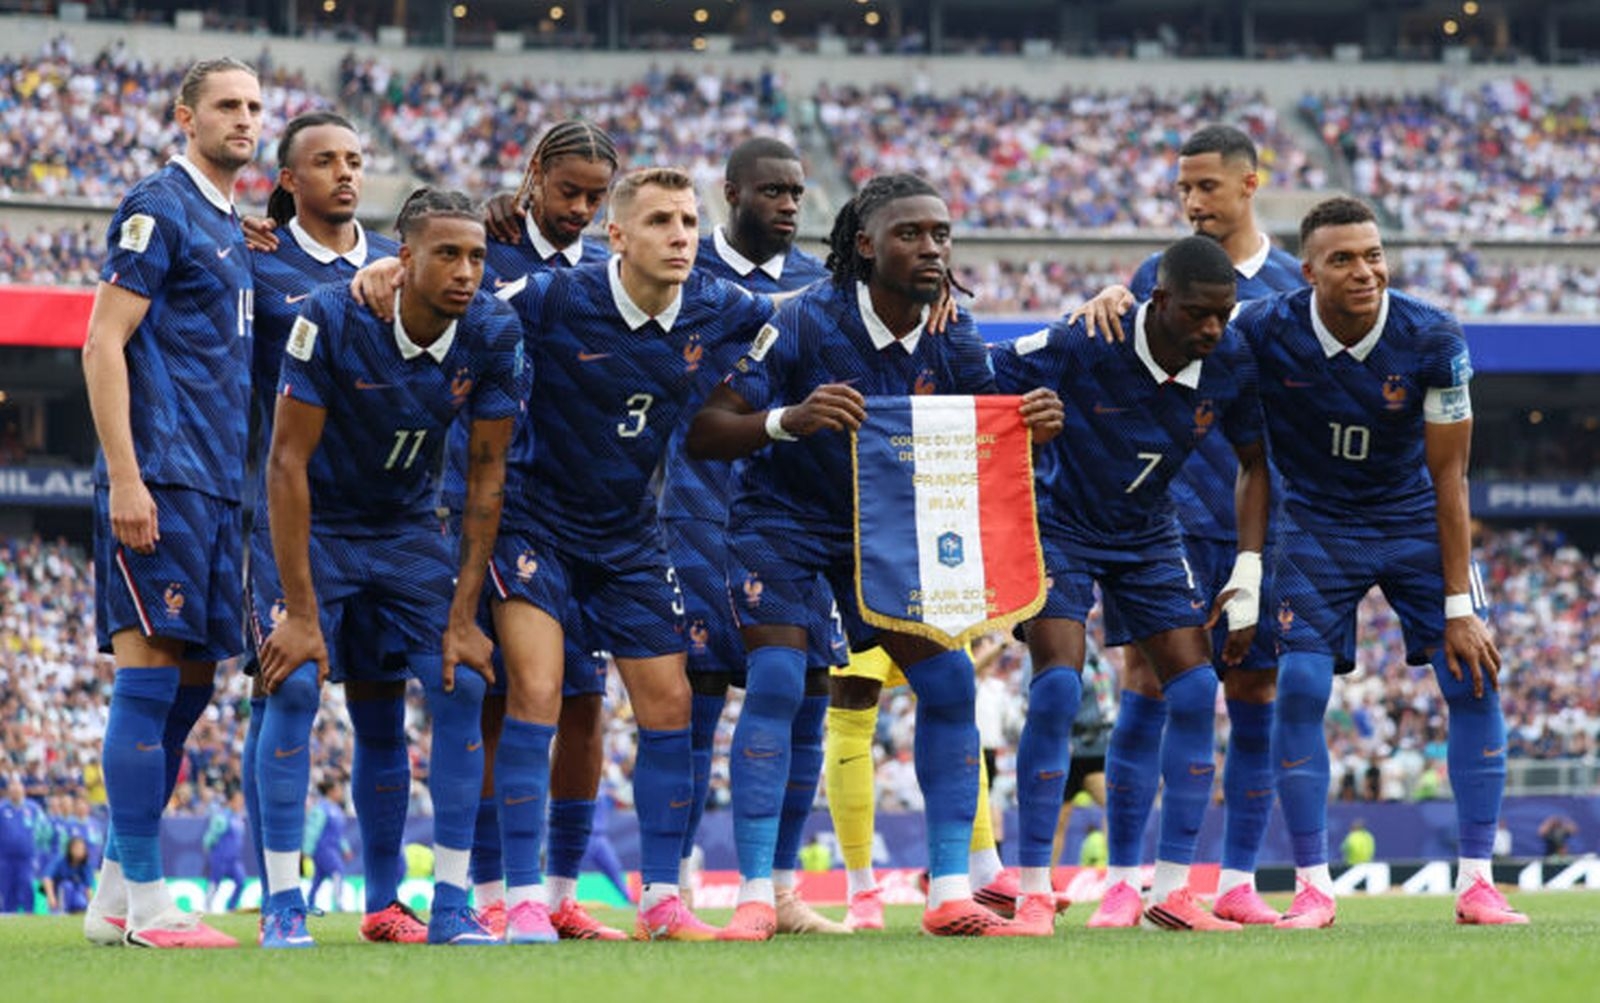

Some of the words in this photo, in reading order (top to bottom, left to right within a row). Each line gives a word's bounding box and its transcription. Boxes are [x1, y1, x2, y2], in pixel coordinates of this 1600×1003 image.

[617, 393, 653, 437] 3
[384, 429, 427, 471] 11
[1328, 422, 1370, 461] 10
[0, 470, 95, 496] ILAD
[912, 472, 979, 487] FRANCE
[1125, 453, 1163, 493] 7
[1487, 483, 1600, 508] PHILA
[666, 566, 685, 615] 3
